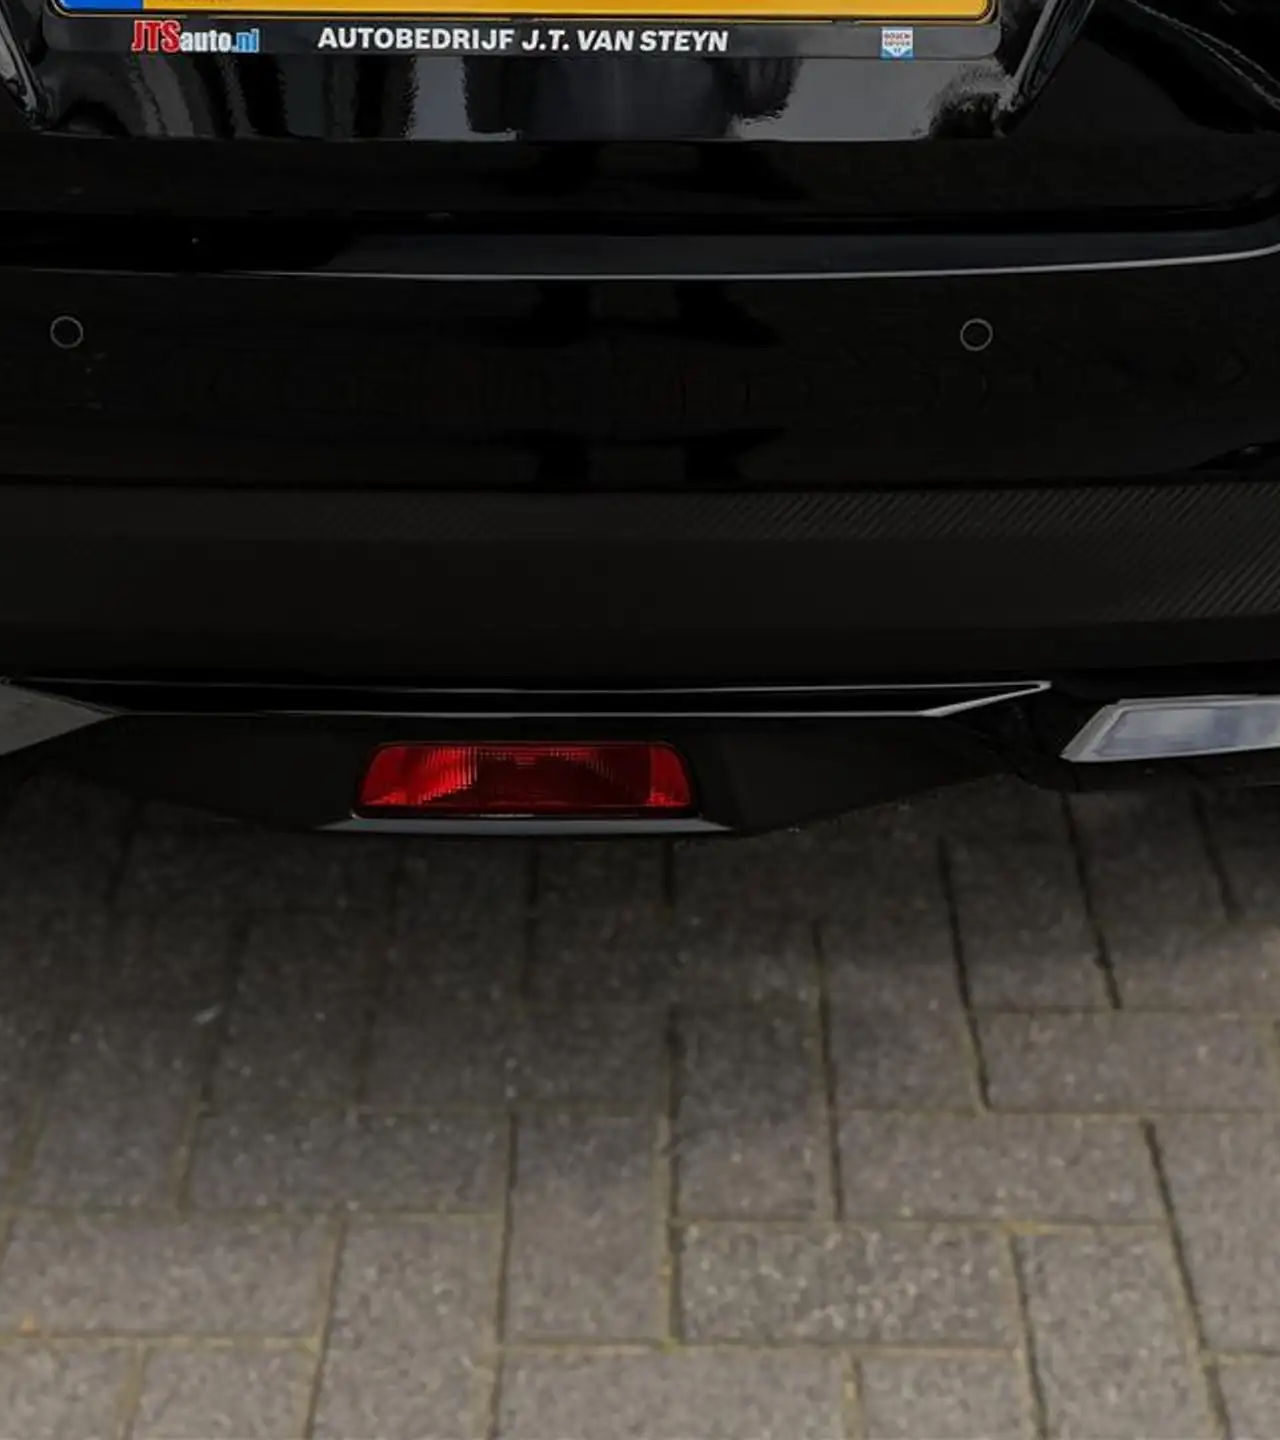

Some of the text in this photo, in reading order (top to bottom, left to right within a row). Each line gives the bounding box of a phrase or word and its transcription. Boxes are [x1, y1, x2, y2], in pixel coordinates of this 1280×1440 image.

[131, 20, 259, 53] JTSauto.nl
[318, 27, 728, 53] AUTOBEDRIJF J.T. VAN STEYN
